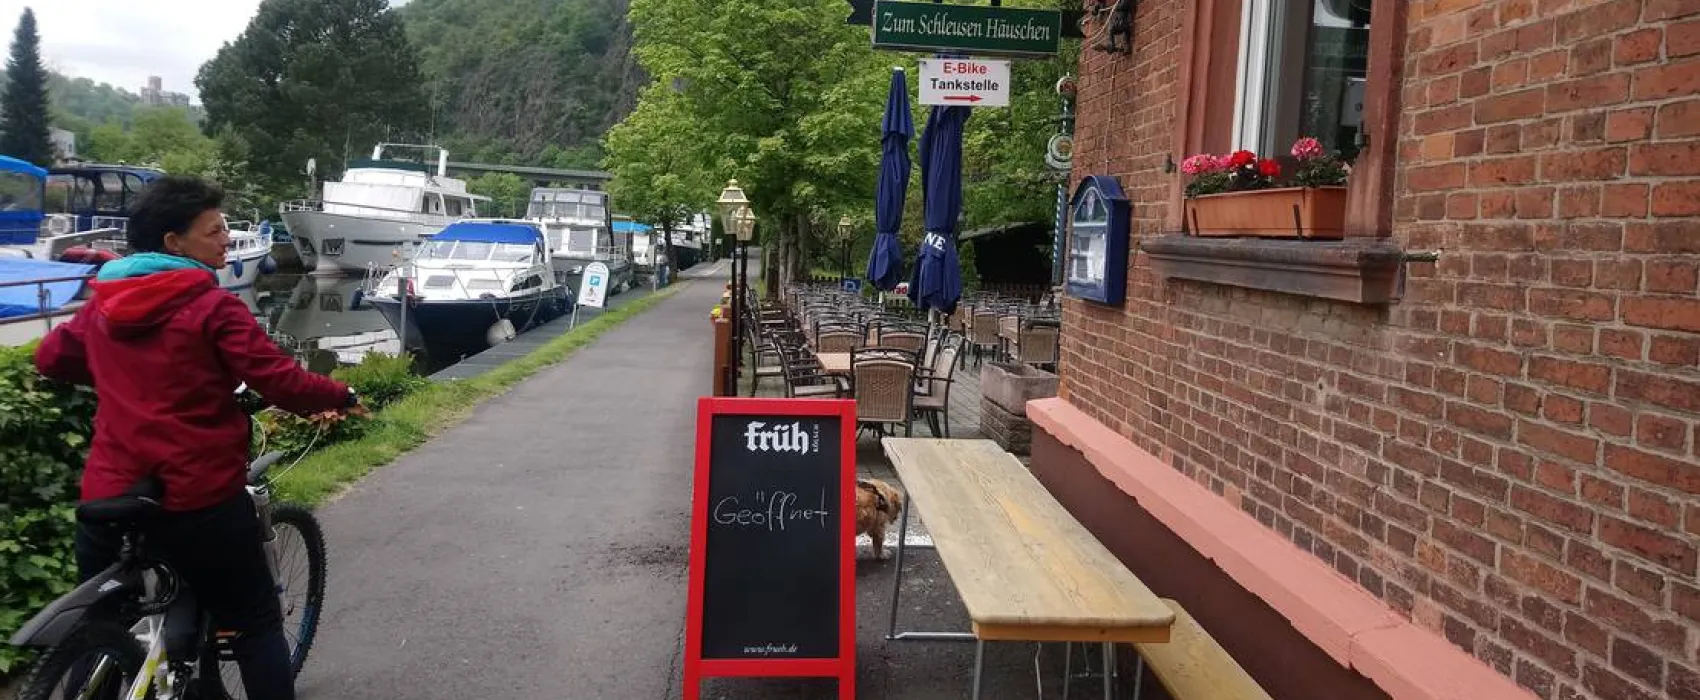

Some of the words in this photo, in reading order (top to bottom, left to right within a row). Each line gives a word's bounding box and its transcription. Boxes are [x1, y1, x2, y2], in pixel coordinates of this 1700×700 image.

[881, 11, 915, 34] Zum
[918, 12, 982, 38] Schleusen
[985, 16, 1051, 41] Häuschen
[943, 62, 988, 75] E-Bike
[930, 77, 1000, 91] Tankstelle
[713, 485, 828, 532] Geöffnet
